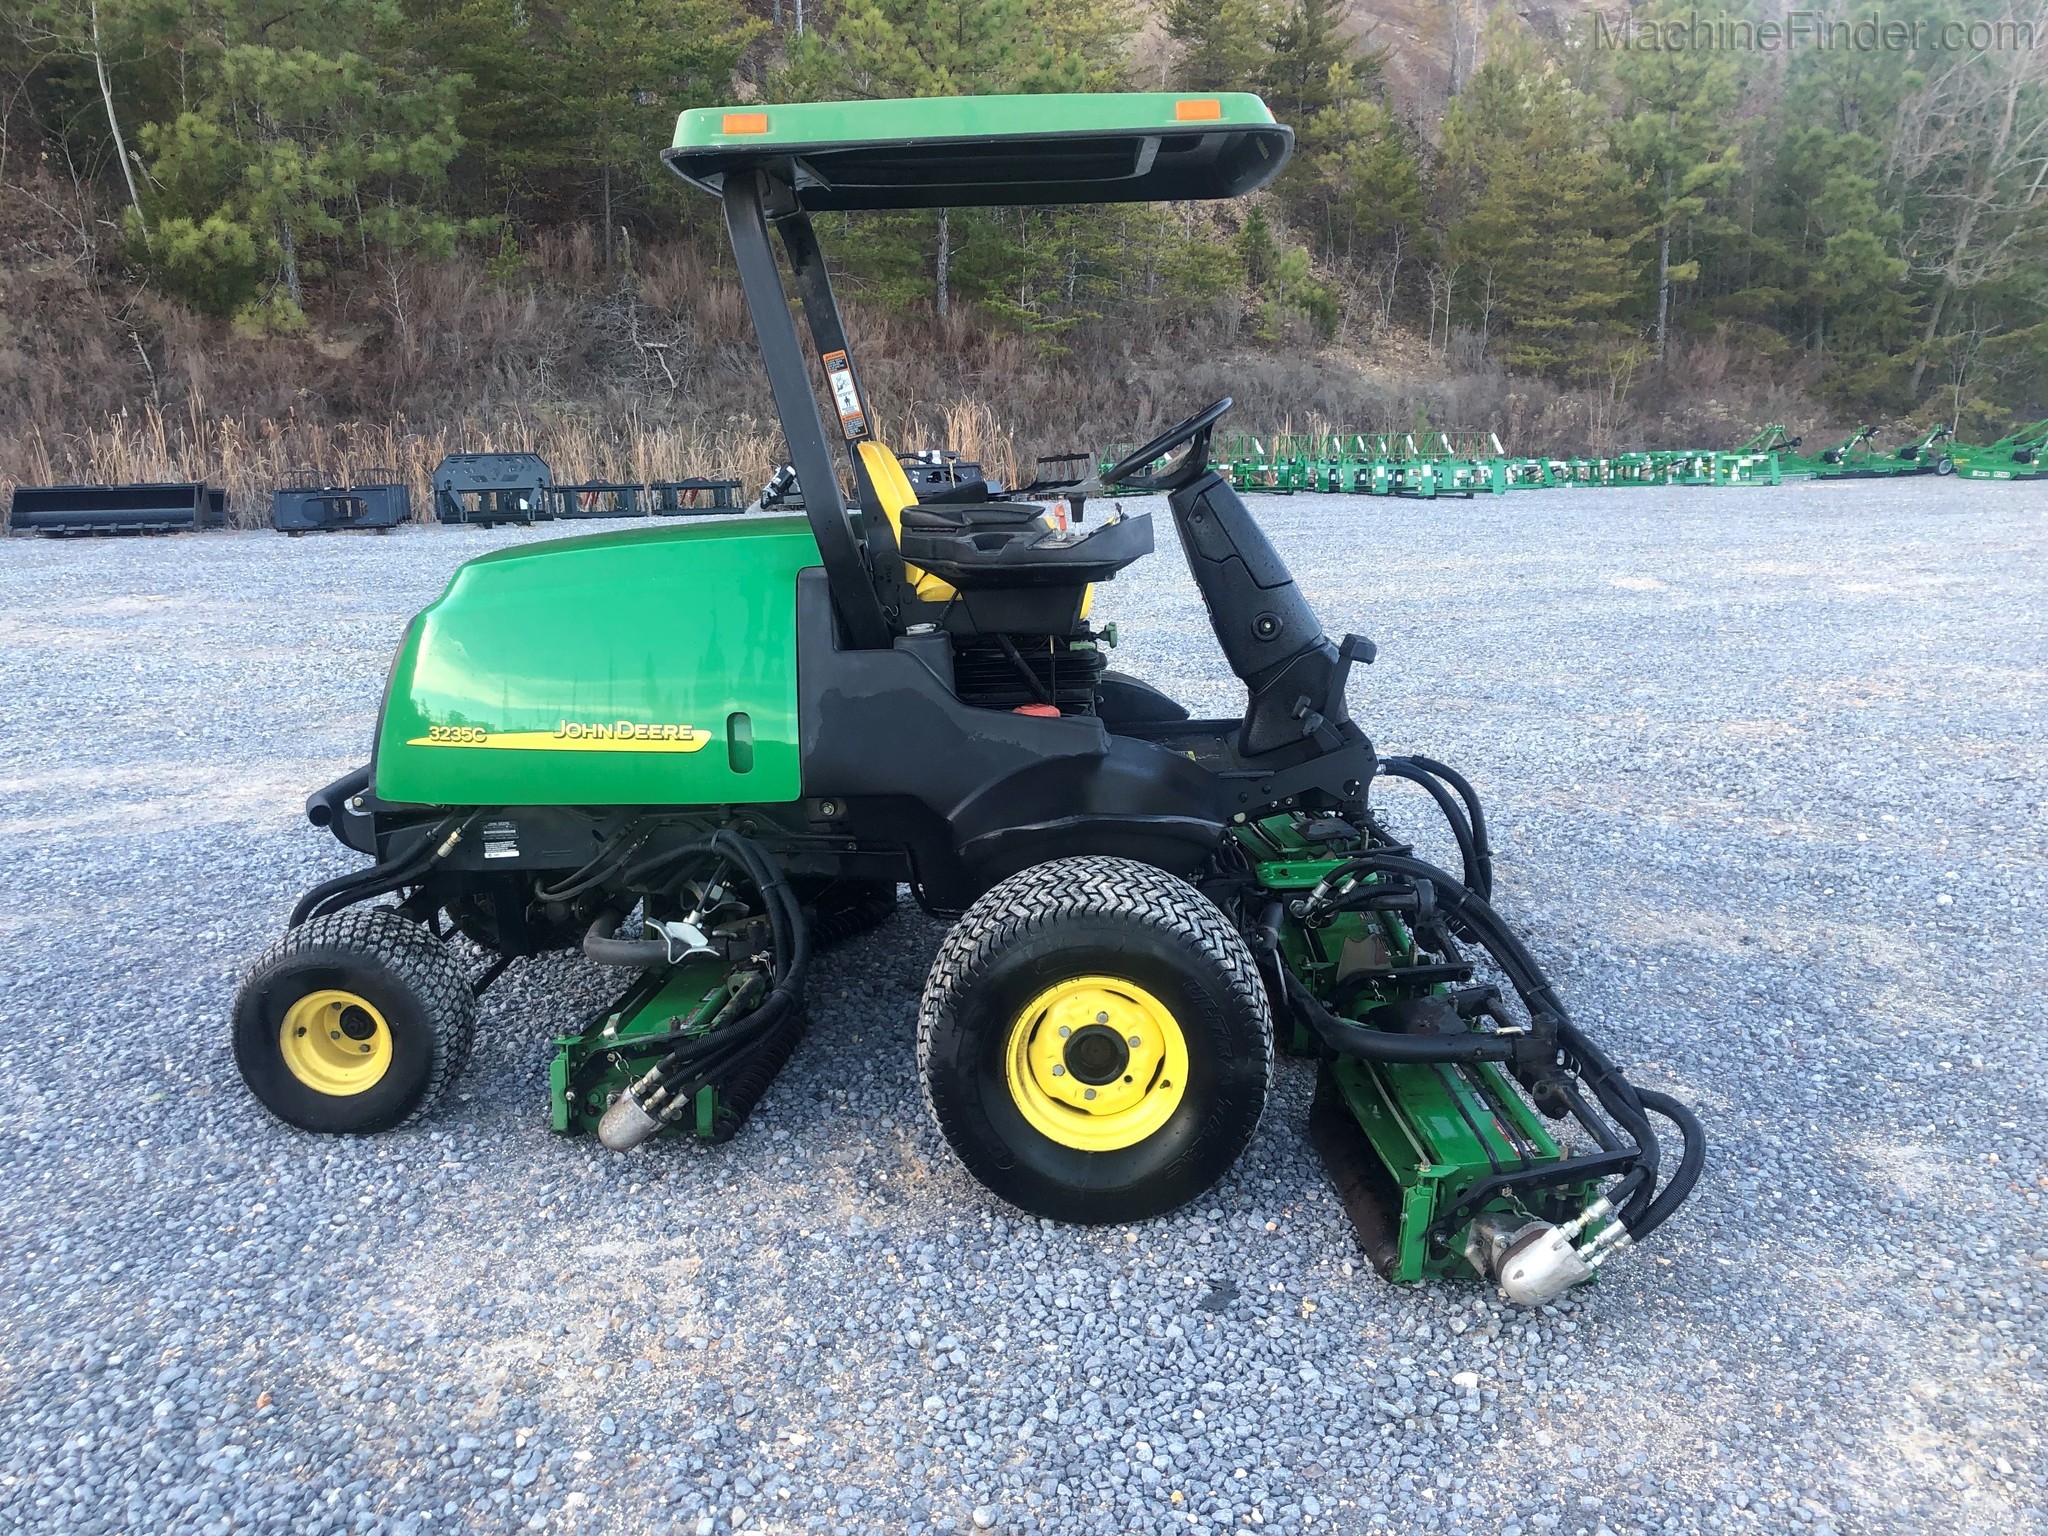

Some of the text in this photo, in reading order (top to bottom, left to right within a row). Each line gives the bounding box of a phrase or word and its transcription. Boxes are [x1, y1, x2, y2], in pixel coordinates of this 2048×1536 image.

[428, 725, 487, 743] 3235C
[553, 719, 694, 741] JOHN DEERE
